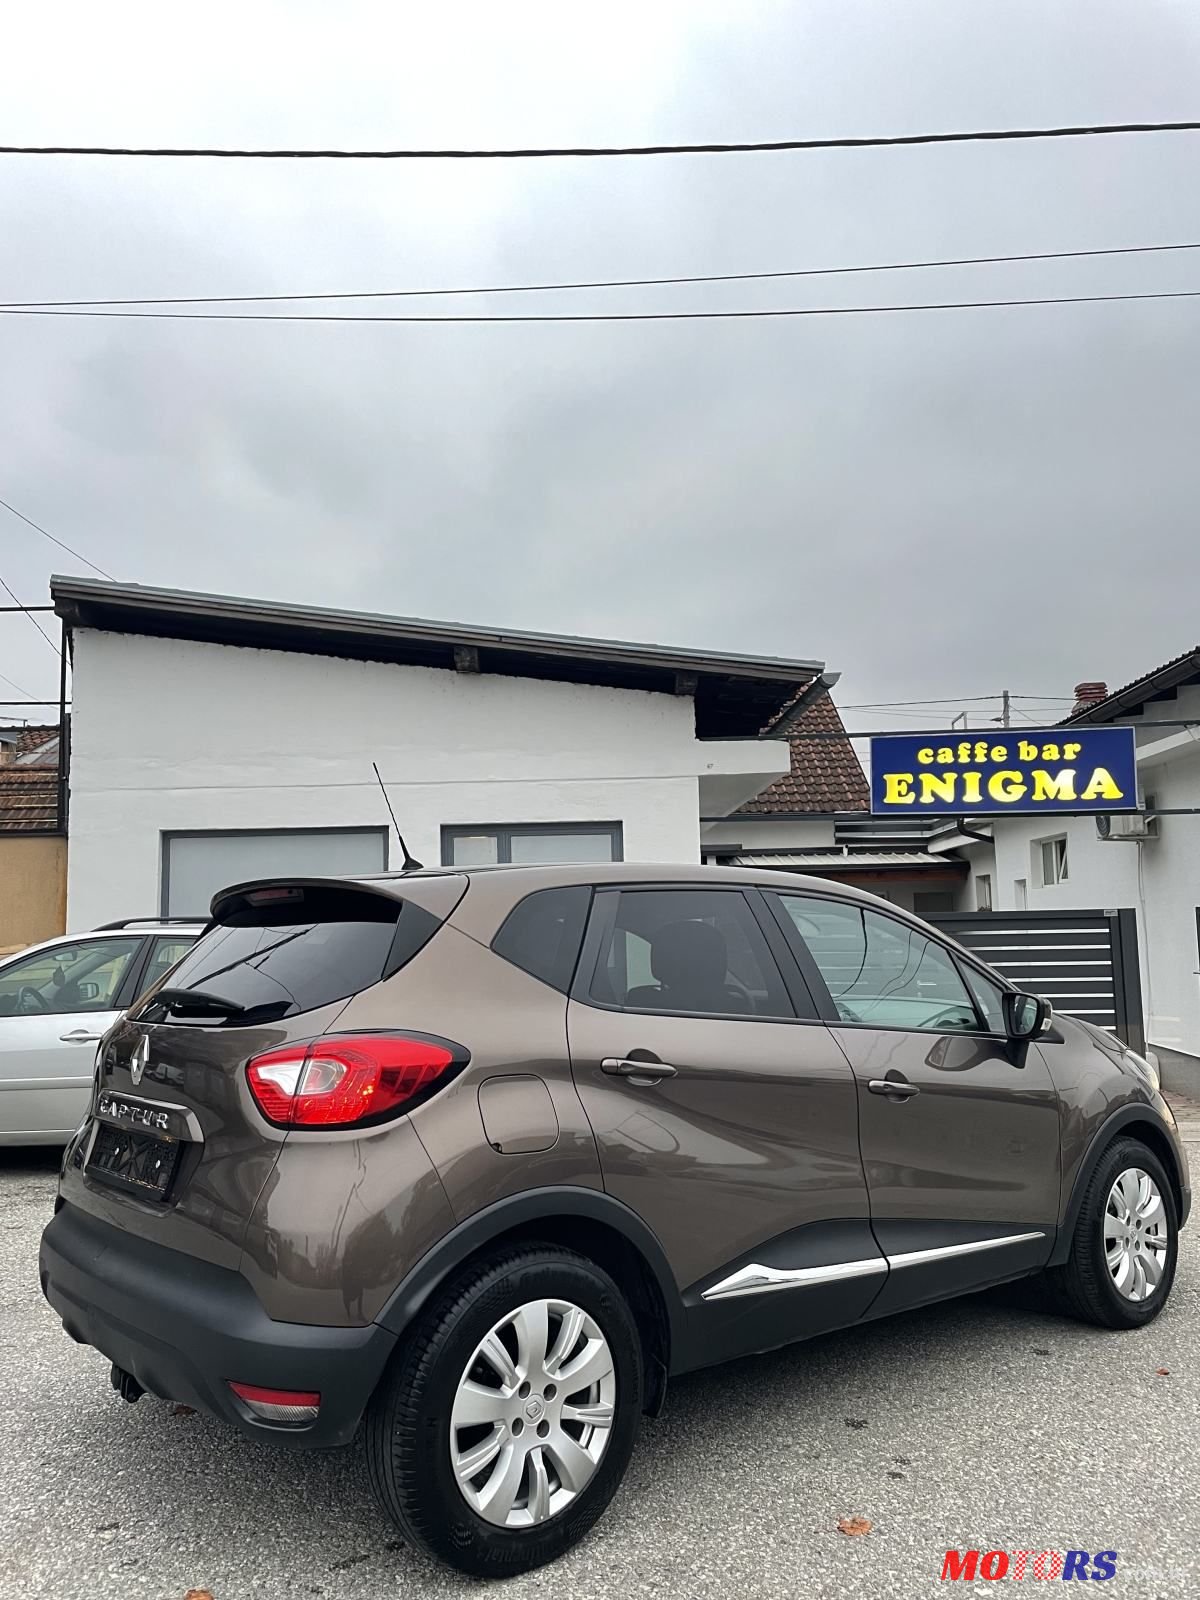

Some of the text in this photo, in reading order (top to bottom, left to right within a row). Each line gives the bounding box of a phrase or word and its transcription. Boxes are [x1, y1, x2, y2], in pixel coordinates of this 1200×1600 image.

[917, 740, 1082, 765] caffe bar
[883, 767, 1124, 804] ENIGMA
[100, 1097, 169, 1129] CAPTUR
